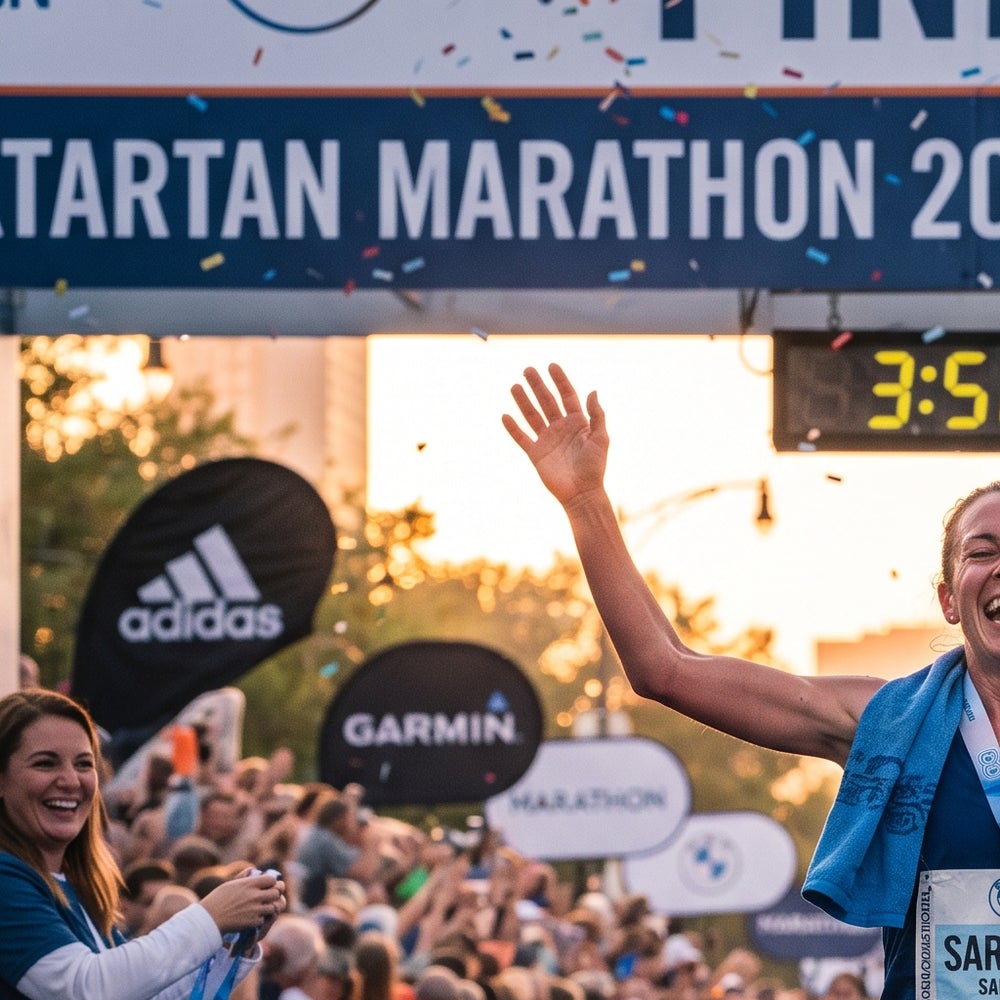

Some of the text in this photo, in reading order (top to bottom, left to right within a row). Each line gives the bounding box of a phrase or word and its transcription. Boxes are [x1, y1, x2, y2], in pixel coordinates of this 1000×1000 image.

[0, 138, 341, 240] TARTAN
[378, 138, 875, 240] MARATHON
[118, 600, 284, 643] adidas
[343, 711, 516, 747] GARMIN
